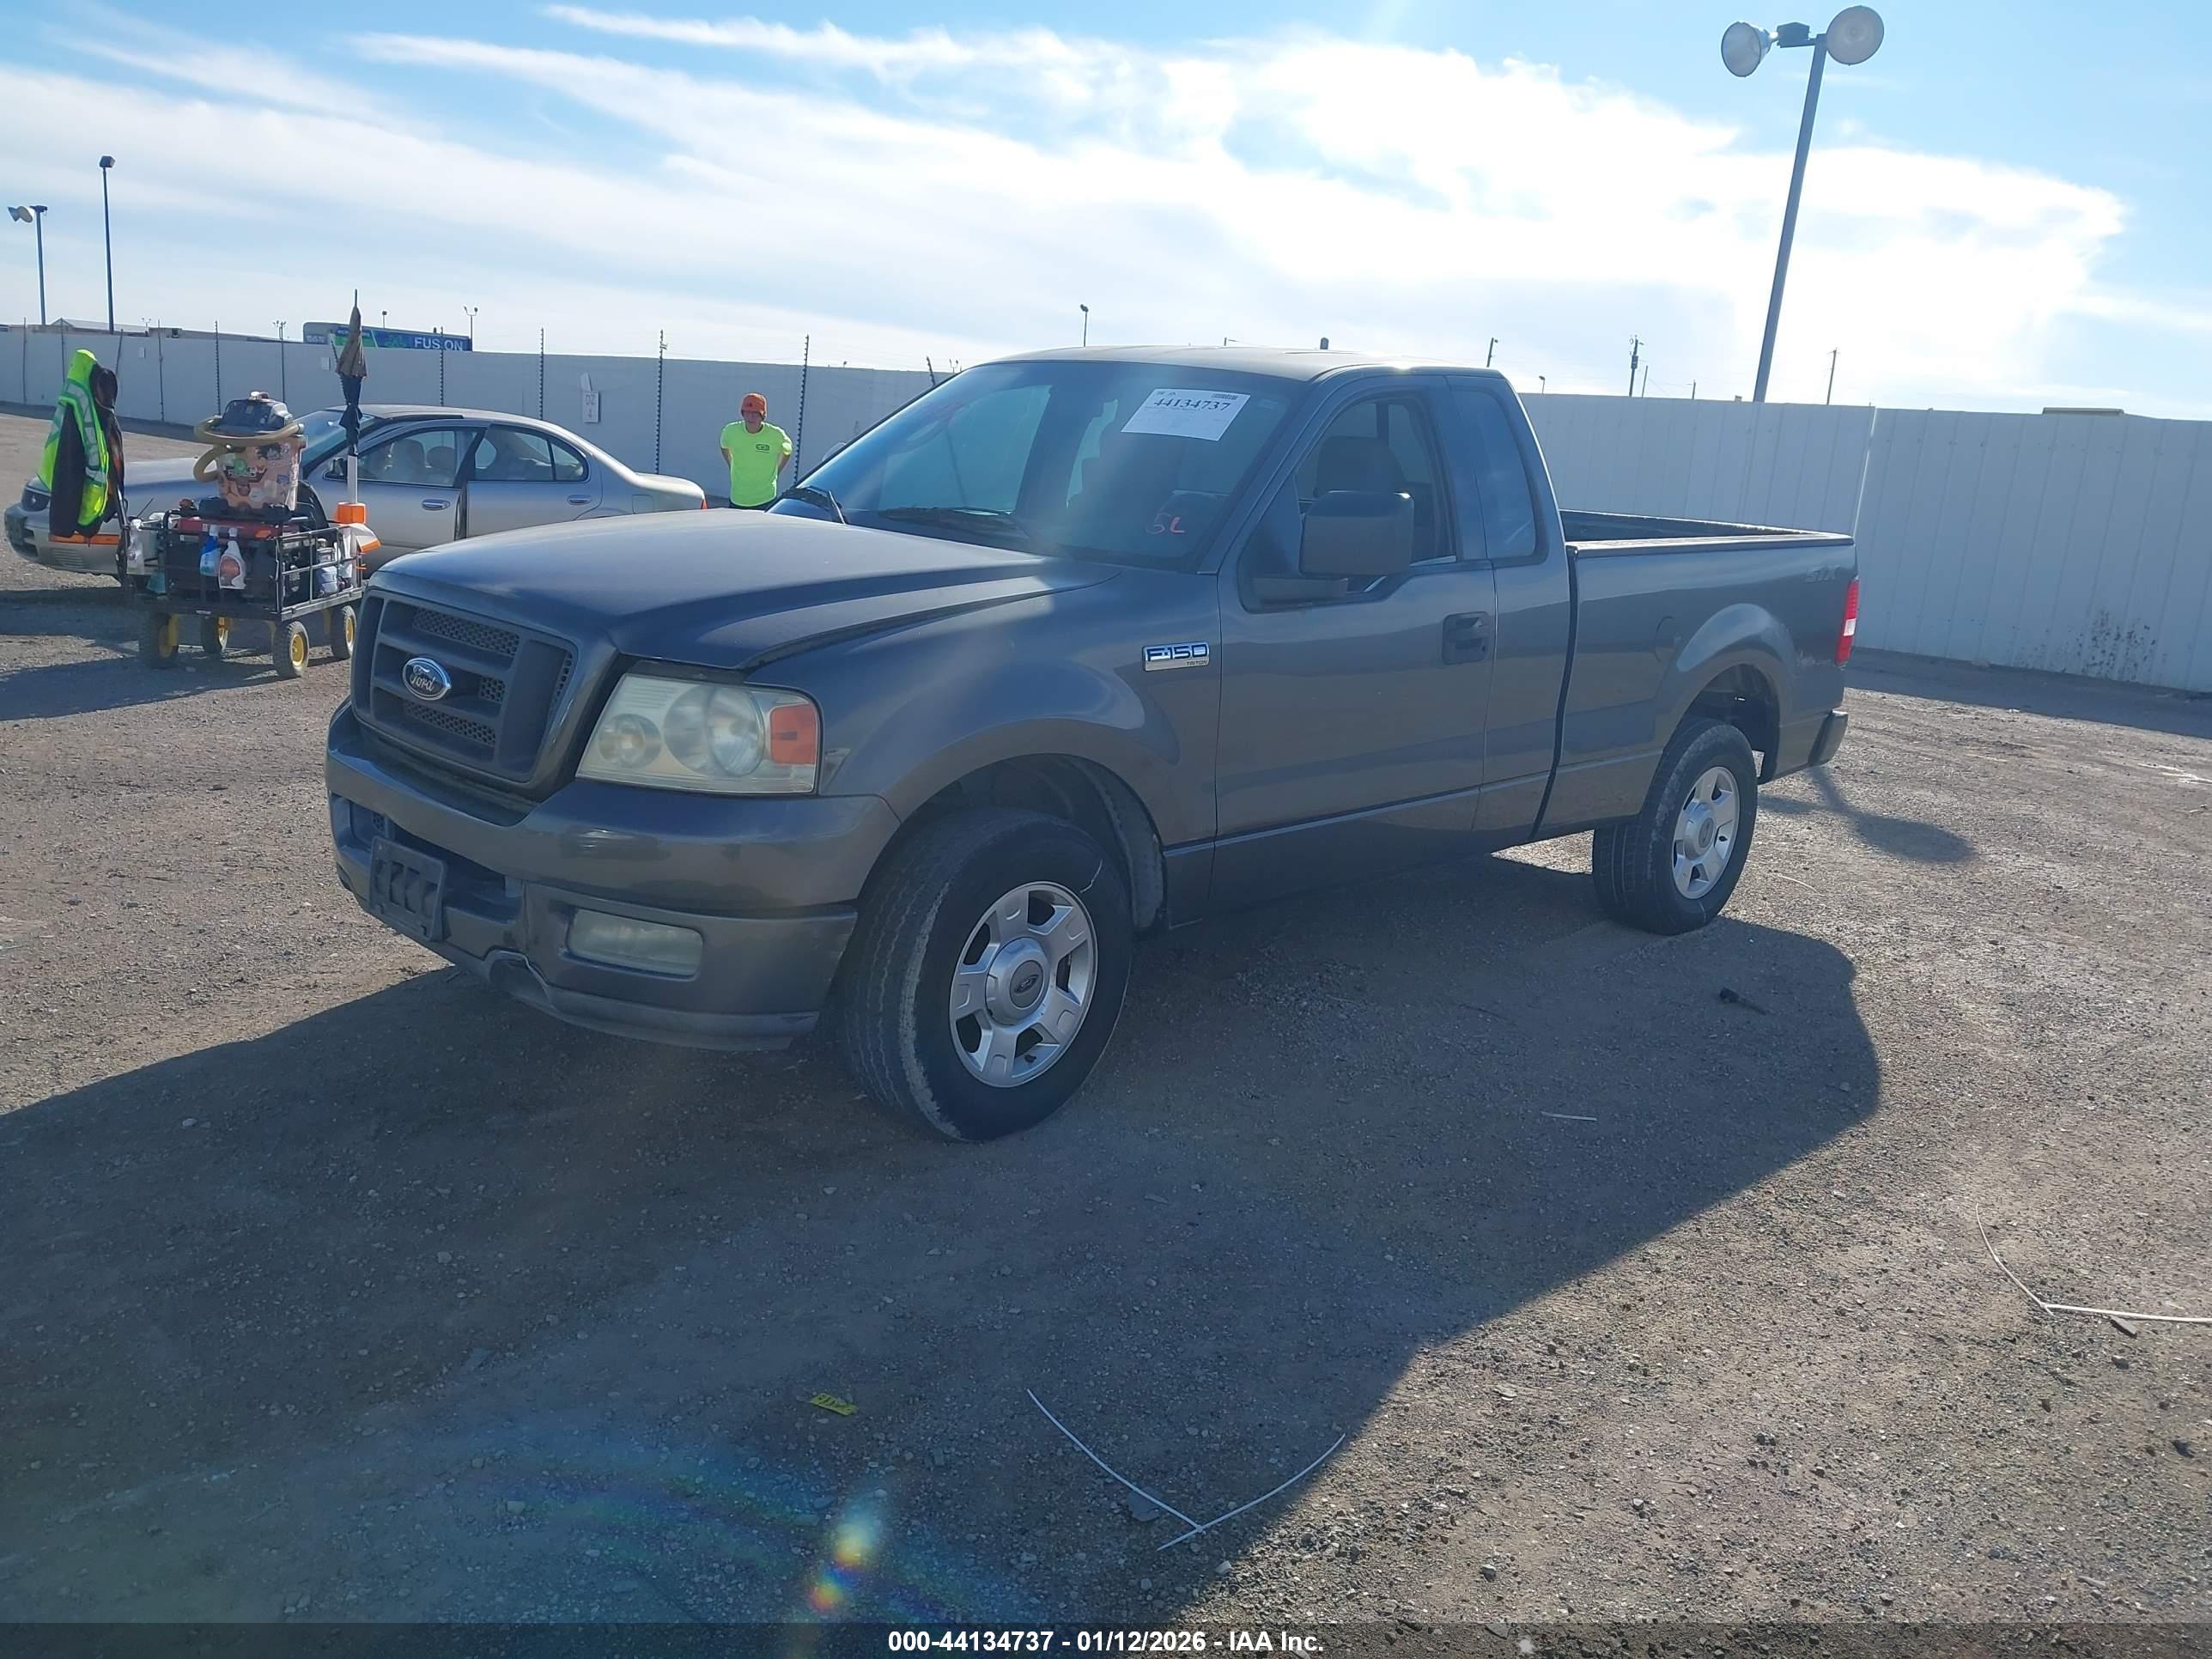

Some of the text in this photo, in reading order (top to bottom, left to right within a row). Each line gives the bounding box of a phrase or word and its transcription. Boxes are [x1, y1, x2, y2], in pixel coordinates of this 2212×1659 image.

[414, 337, 464, 351] FUSON
[1153, 398, 1231, 411] 44134737
[1147, 644, 1207, 661] F-150
[410, 665, 436, 691] Ford
